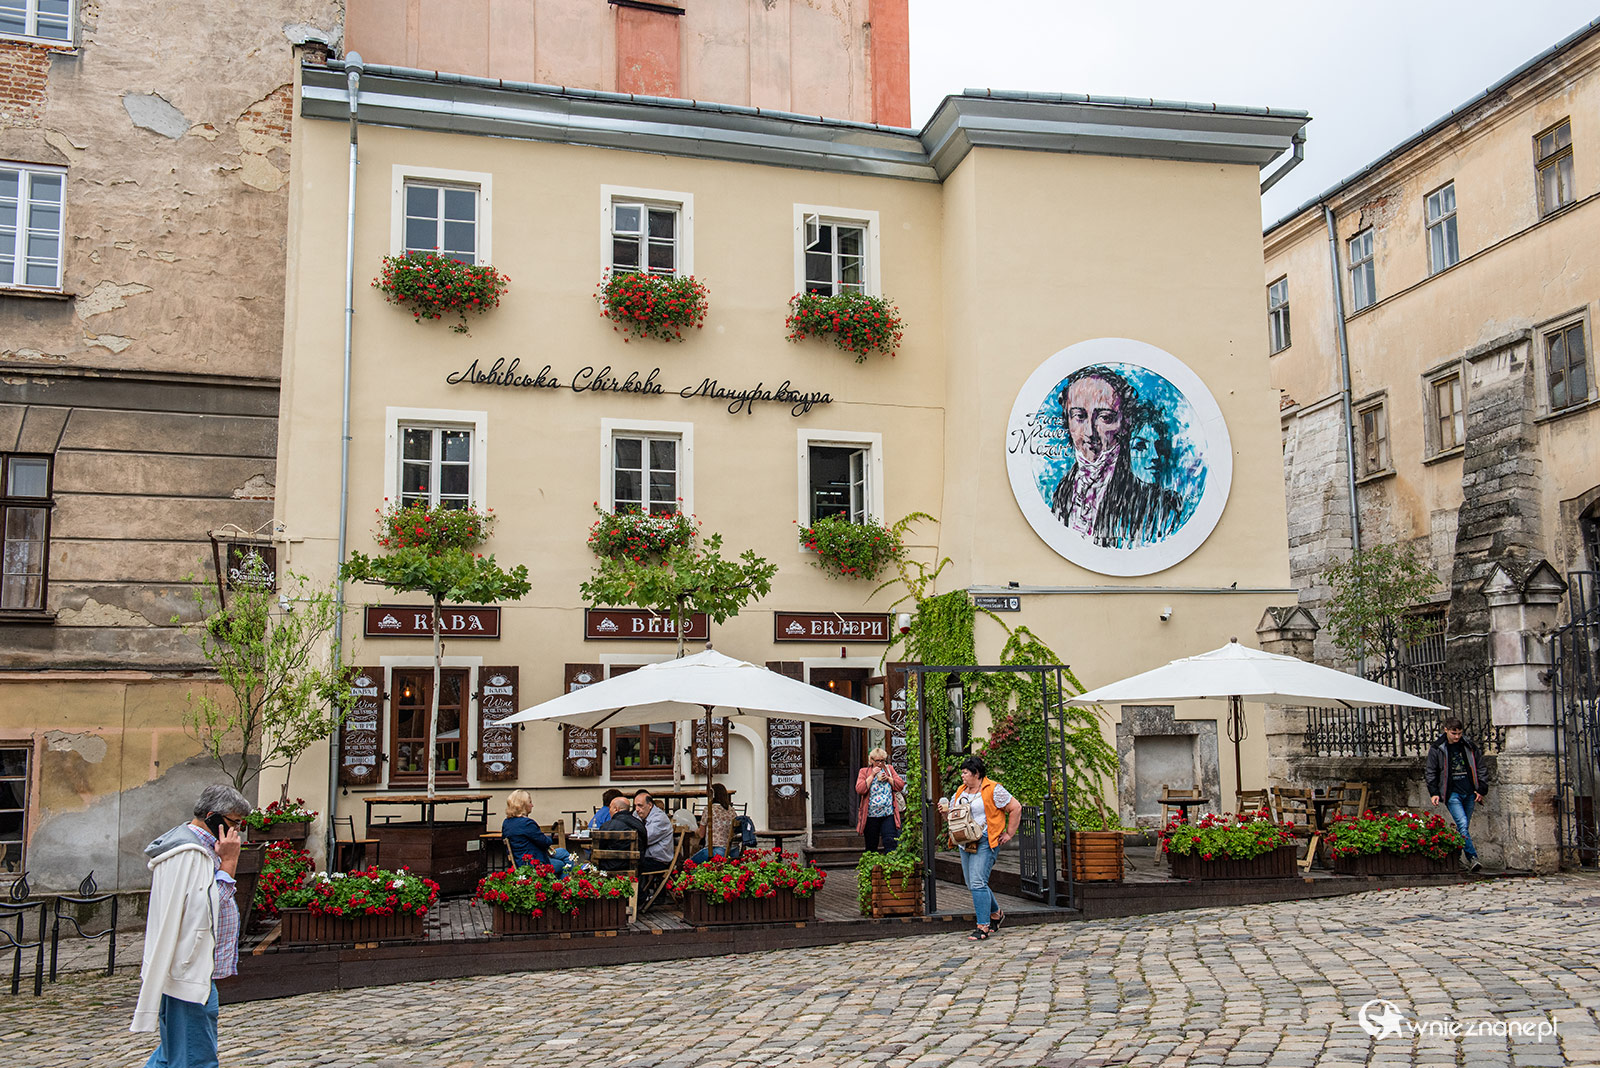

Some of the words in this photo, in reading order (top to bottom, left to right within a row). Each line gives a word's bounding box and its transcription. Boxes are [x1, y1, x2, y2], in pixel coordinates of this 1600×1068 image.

[446, 357, 561, 389] Львівська
[571, 365, 665, 393] Свічкова
[680, 378, 834, 417] Мануфактура
[1026, 412, 1063, 427] Franz
[1003, 599, 1008, 608] 1
[810, 620, 883, 636] ЕКЛЕРИ
[483, 695, 513, 708] Wine
